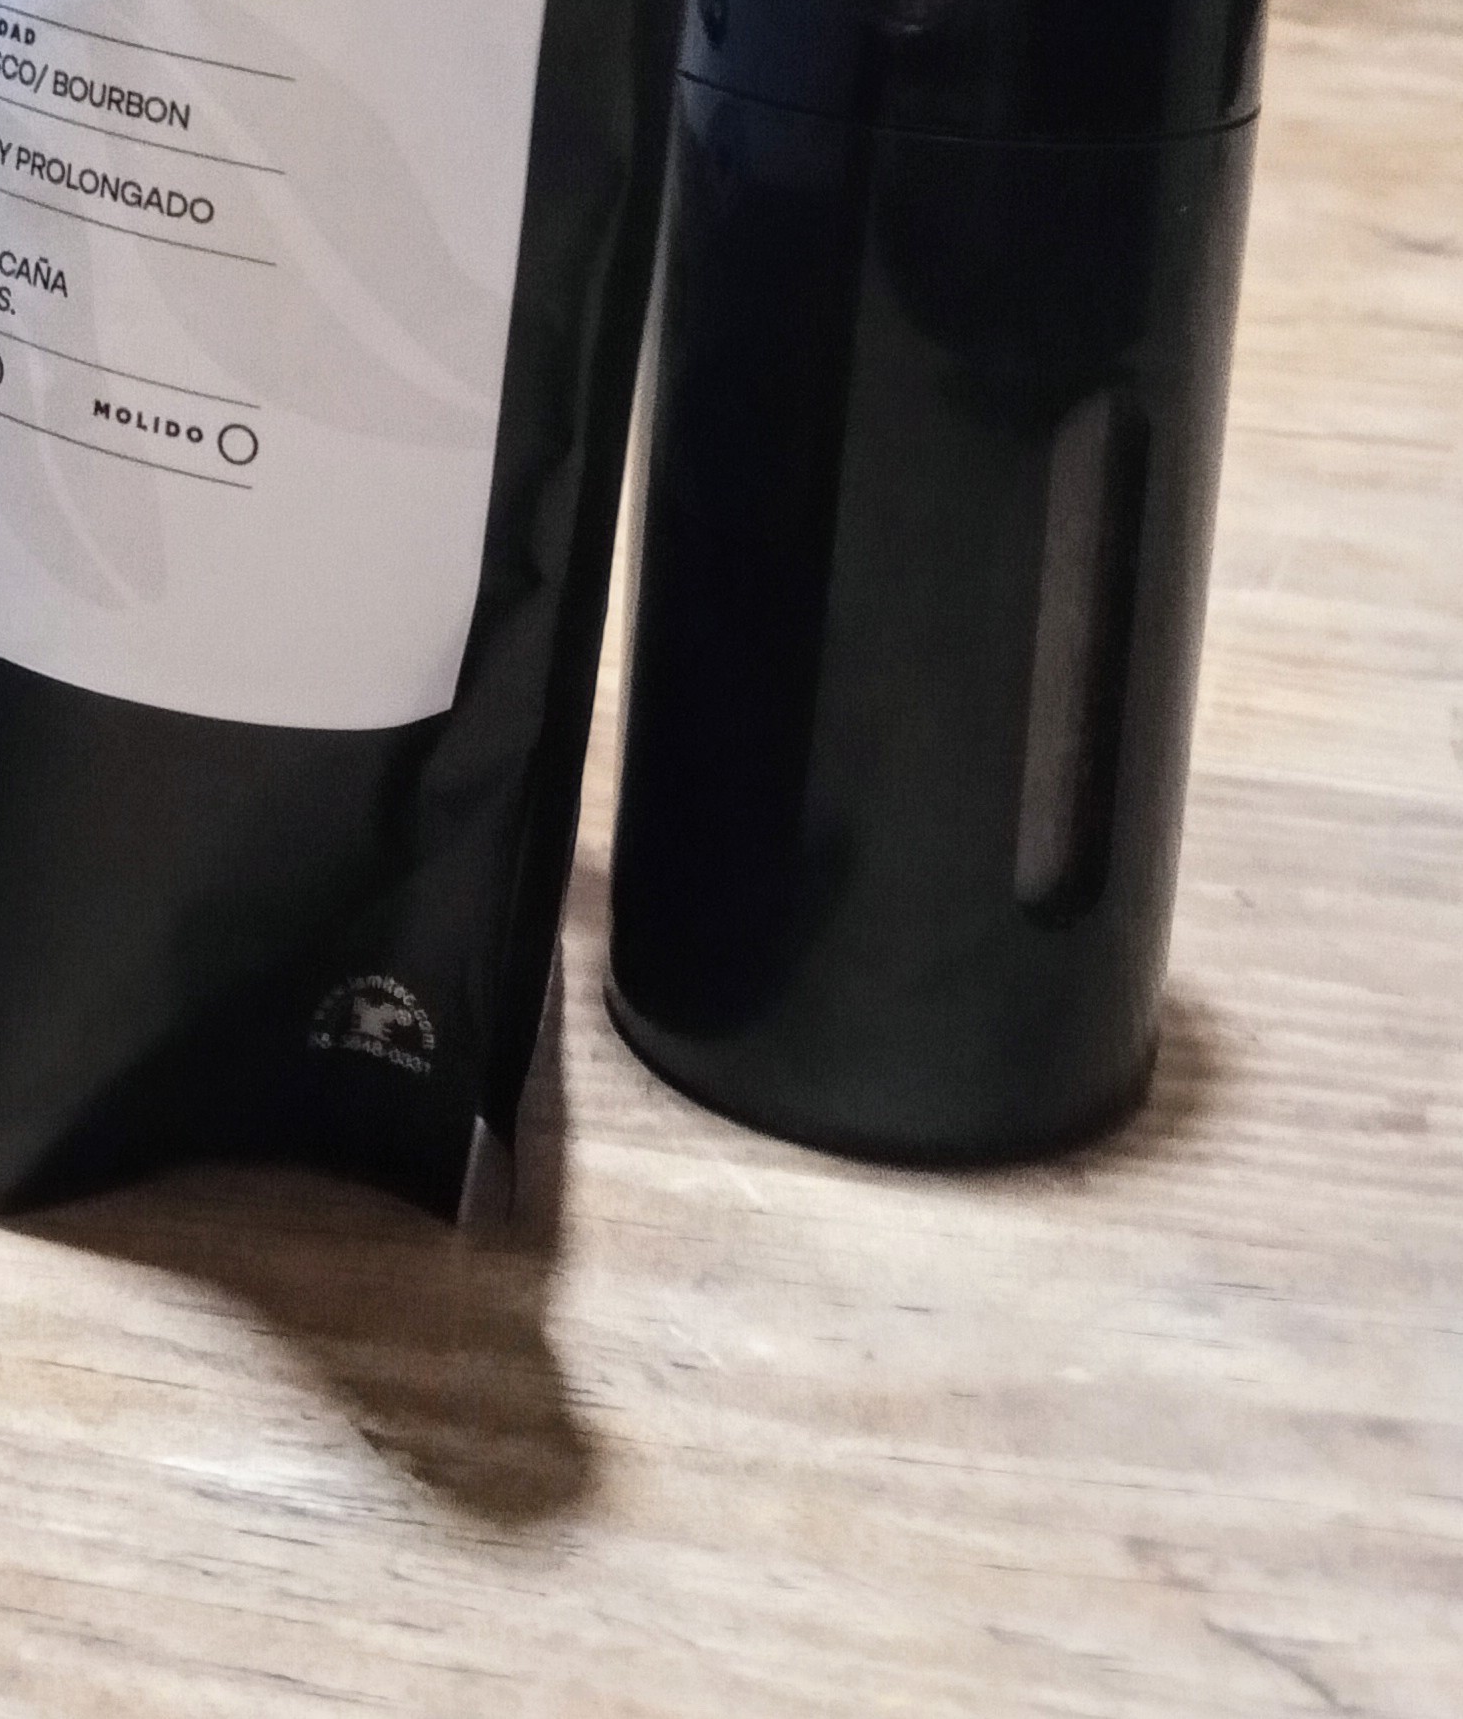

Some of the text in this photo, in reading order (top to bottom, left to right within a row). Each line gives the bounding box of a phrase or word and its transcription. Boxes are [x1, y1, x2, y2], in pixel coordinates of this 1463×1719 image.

[51, 68, 192, 131] BOURBON
[14, 144, 216, 225] PROLONGADO
[92, 398, 205, 445] MOLIDO
